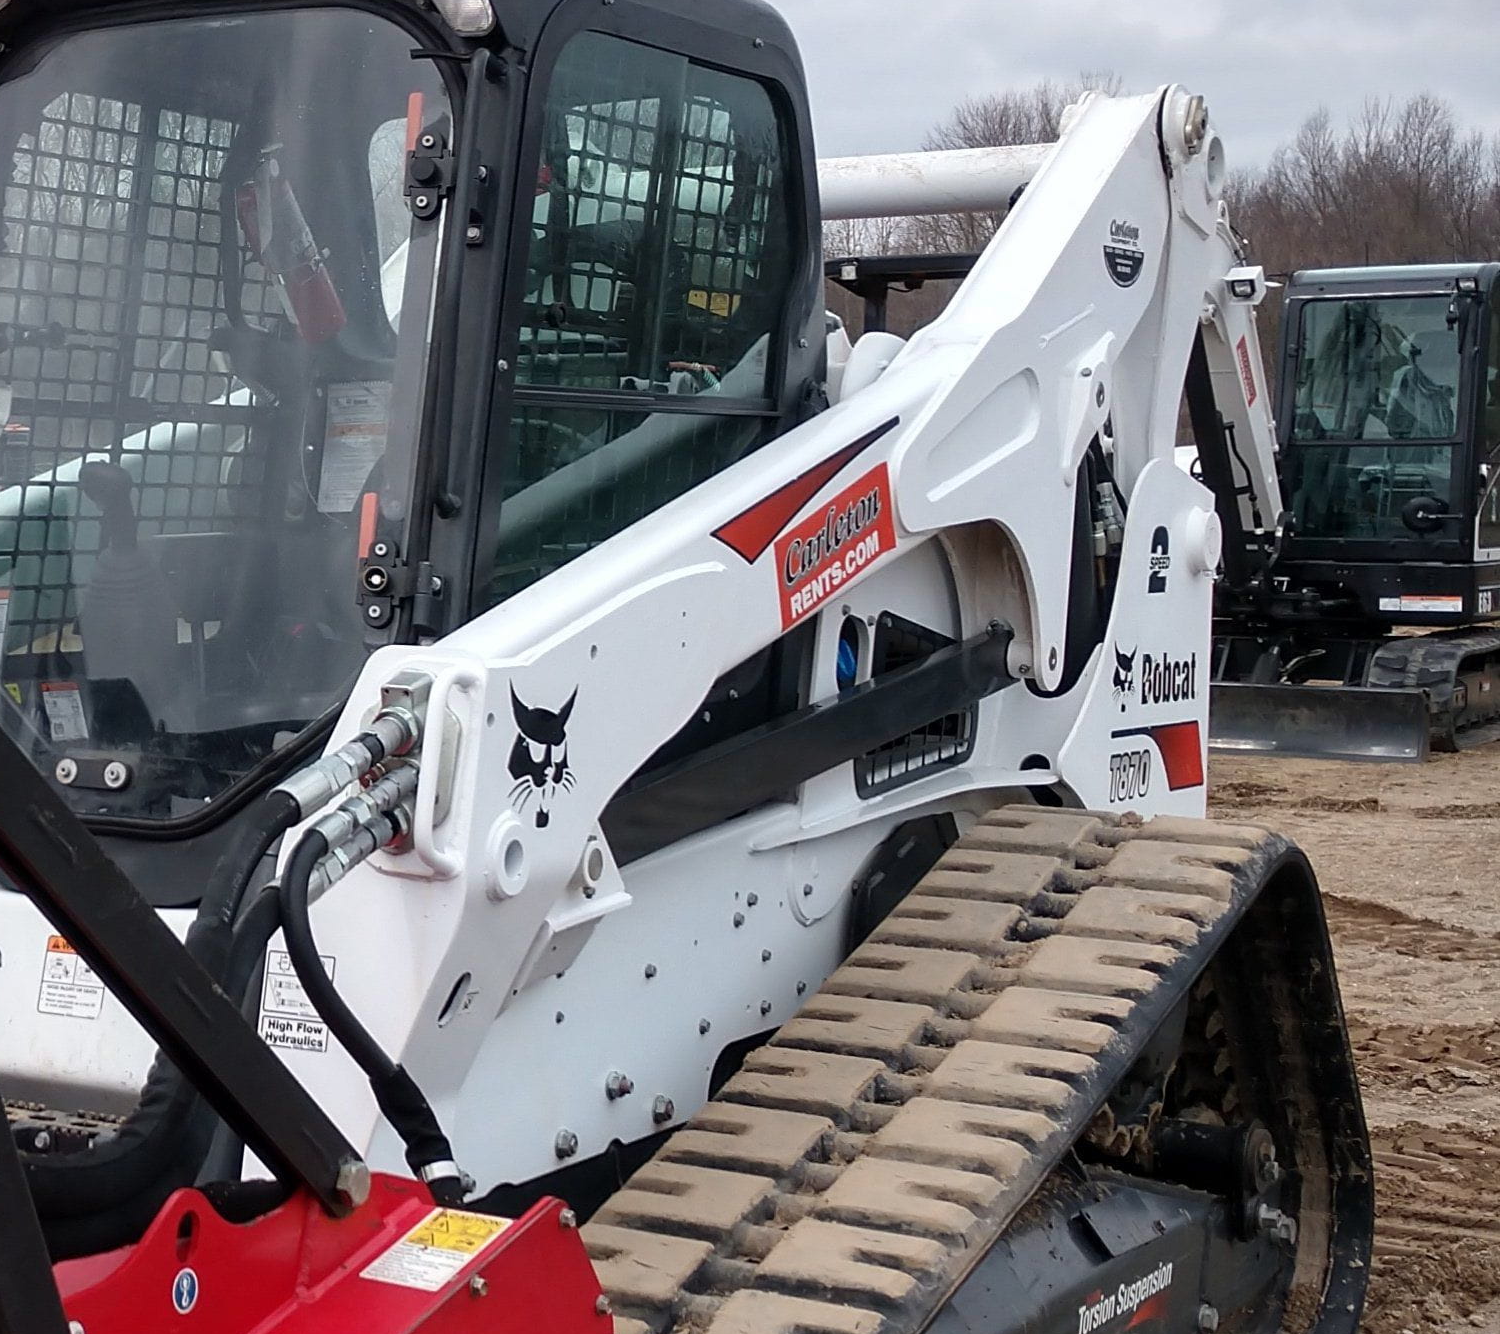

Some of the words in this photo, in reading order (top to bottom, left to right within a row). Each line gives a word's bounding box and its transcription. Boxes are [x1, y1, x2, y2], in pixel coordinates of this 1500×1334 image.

[784, 485, 881, 588] Carleton
[1149, 556, 1170, 570] SPEED
[790, 530, 880, 620] RENTS.COM
[1140, 651, 1197, 705] Bobcat
[1109, 749, 1151, 803] T870
[265, 1031, 324, 1047] Hydraulics
[267, 1019, 293, 1033] High
[297, 1022, 323, 1035] Flow
[1116, 1261, 1173, 1315] Suspension
